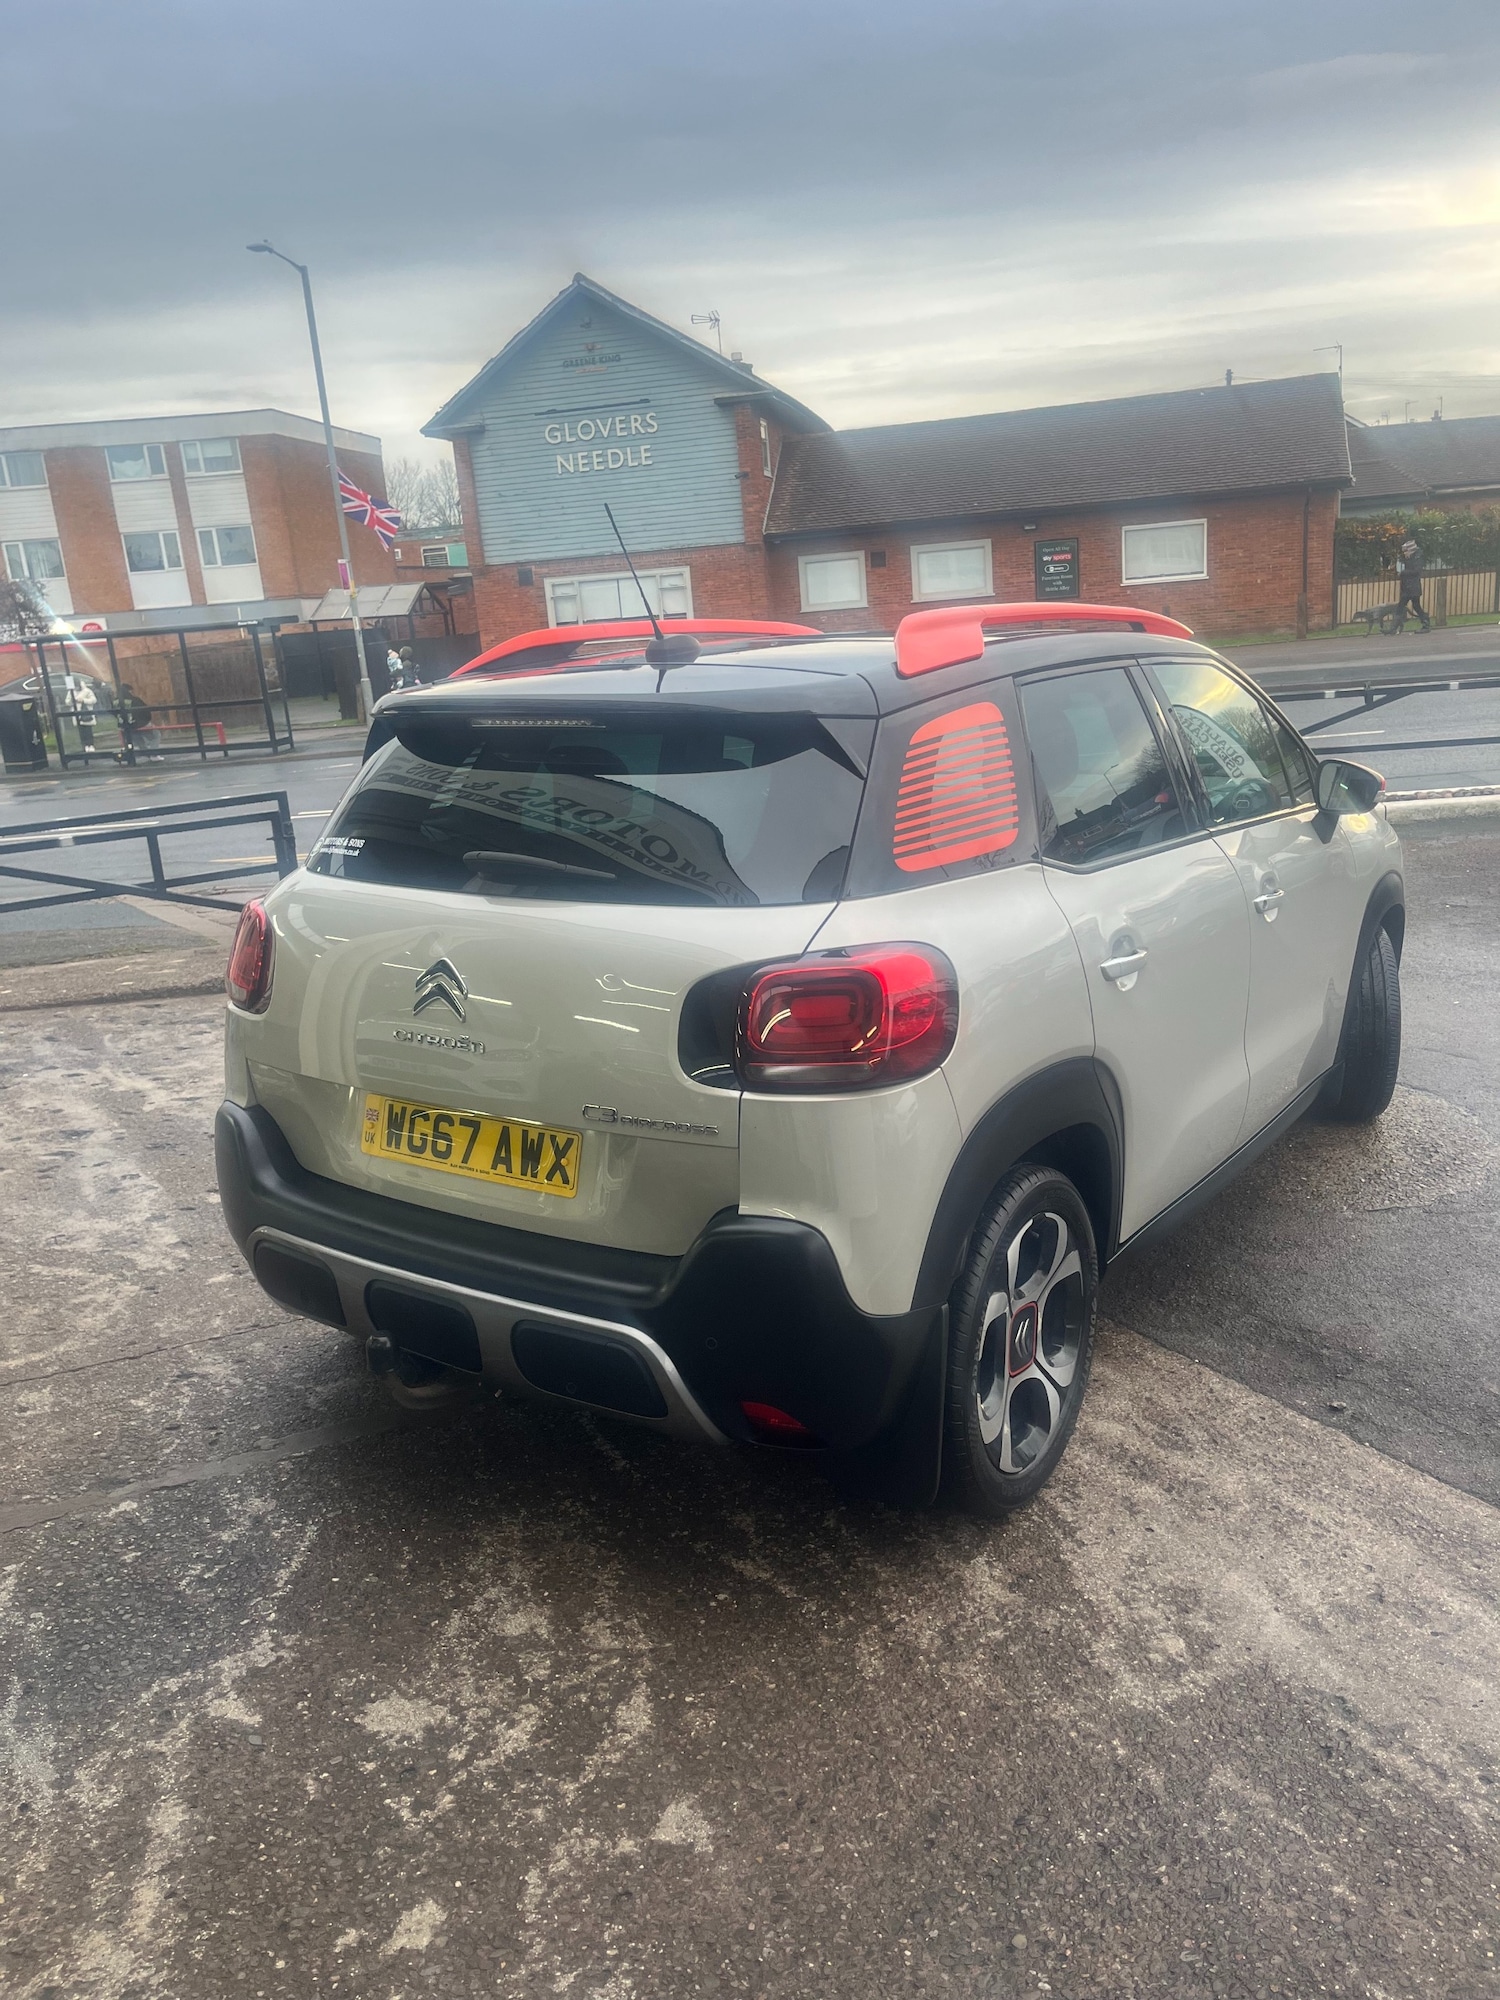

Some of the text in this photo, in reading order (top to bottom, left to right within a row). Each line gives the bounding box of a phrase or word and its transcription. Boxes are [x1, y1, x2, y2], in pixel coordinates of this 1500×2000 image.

[562, 354, 622, 368] GREENE KING
[544, 412, 659, 445] GLOVERS
[556, 445, 654, 475] NEEDLE
[348, 838, 366, 848] SONS
[582, 1103, 719, 1136] C3 AIRCROSS
[364, 1131, 376, 1145] UK
[385, 1102, 575, 1186] WG67 AWX
